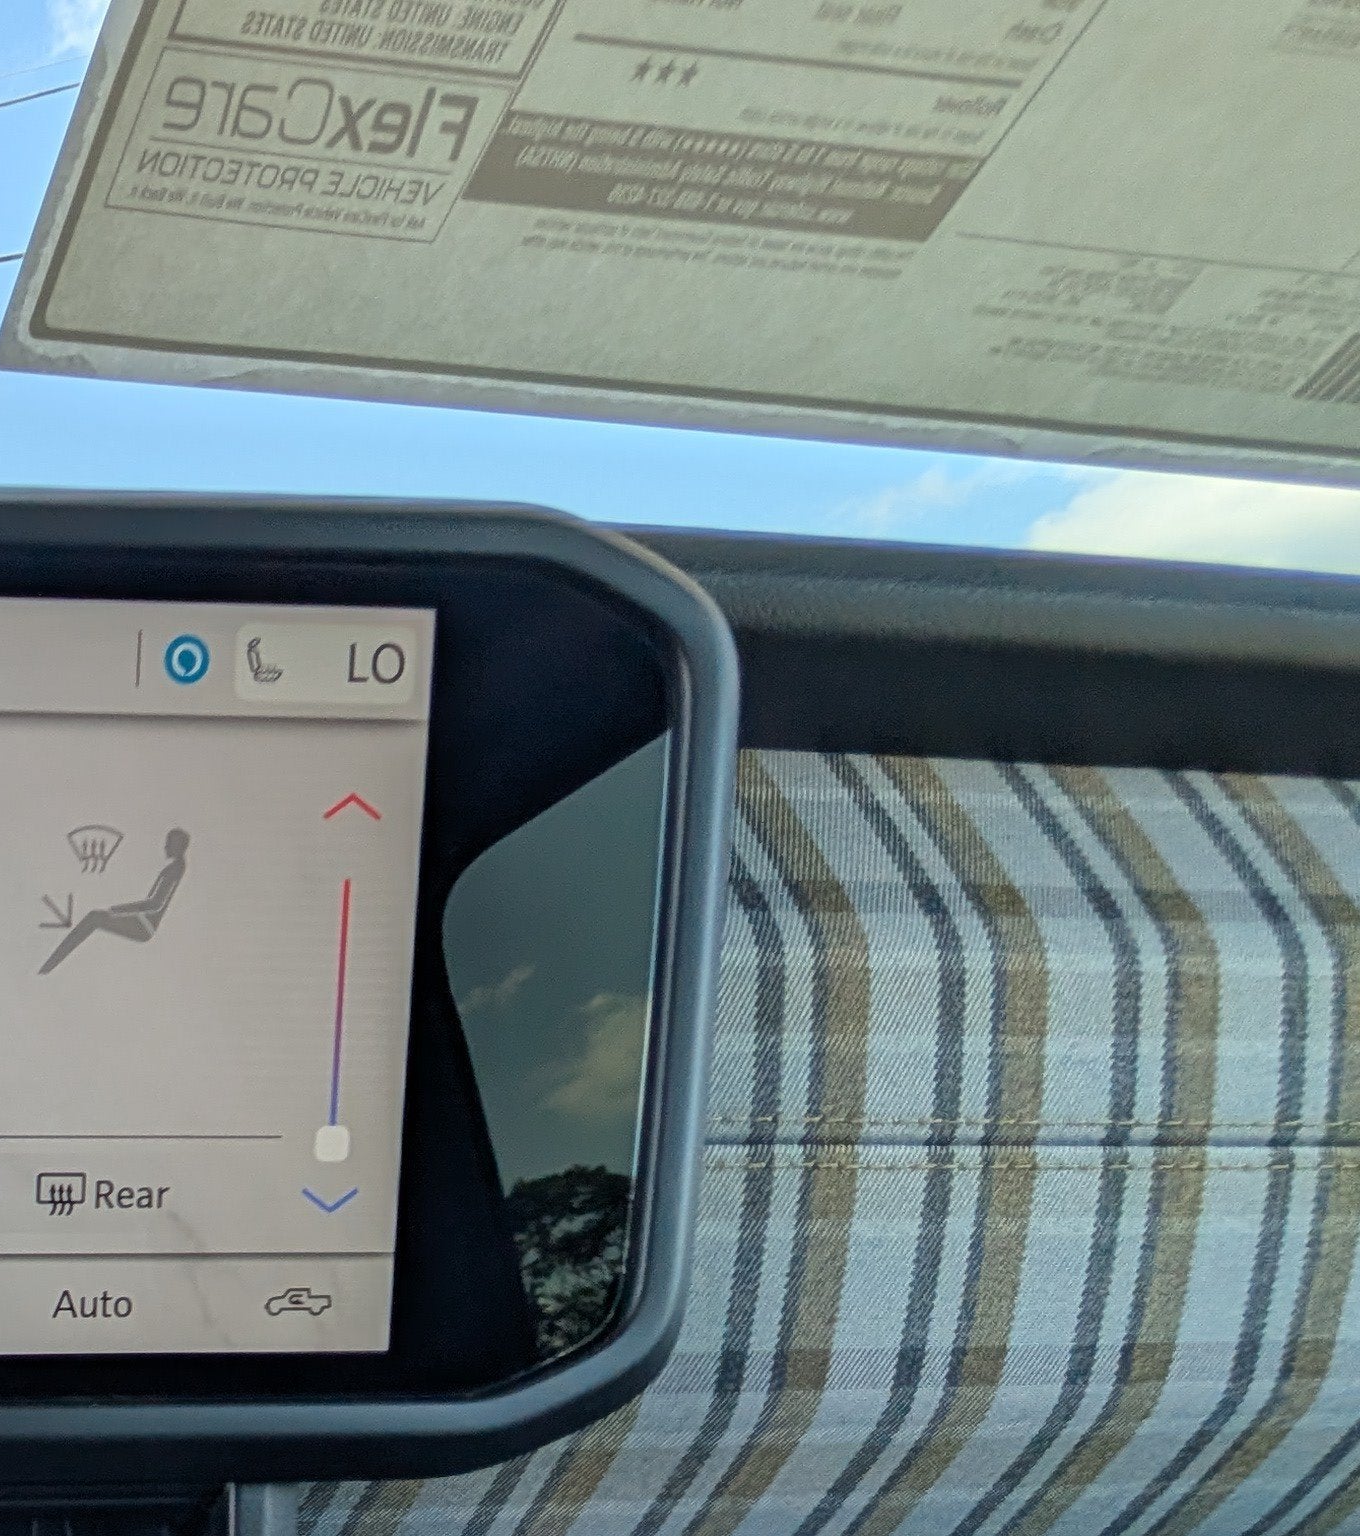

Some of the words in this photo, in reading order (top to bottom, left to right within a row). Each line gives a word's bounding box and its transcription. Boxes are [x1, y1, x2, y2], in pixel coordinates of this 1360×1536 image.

[347, 642, 406, 684] LO
[94, 1179, 171, 1210] Rear
[51, 1289, 134, 1320] Auto
